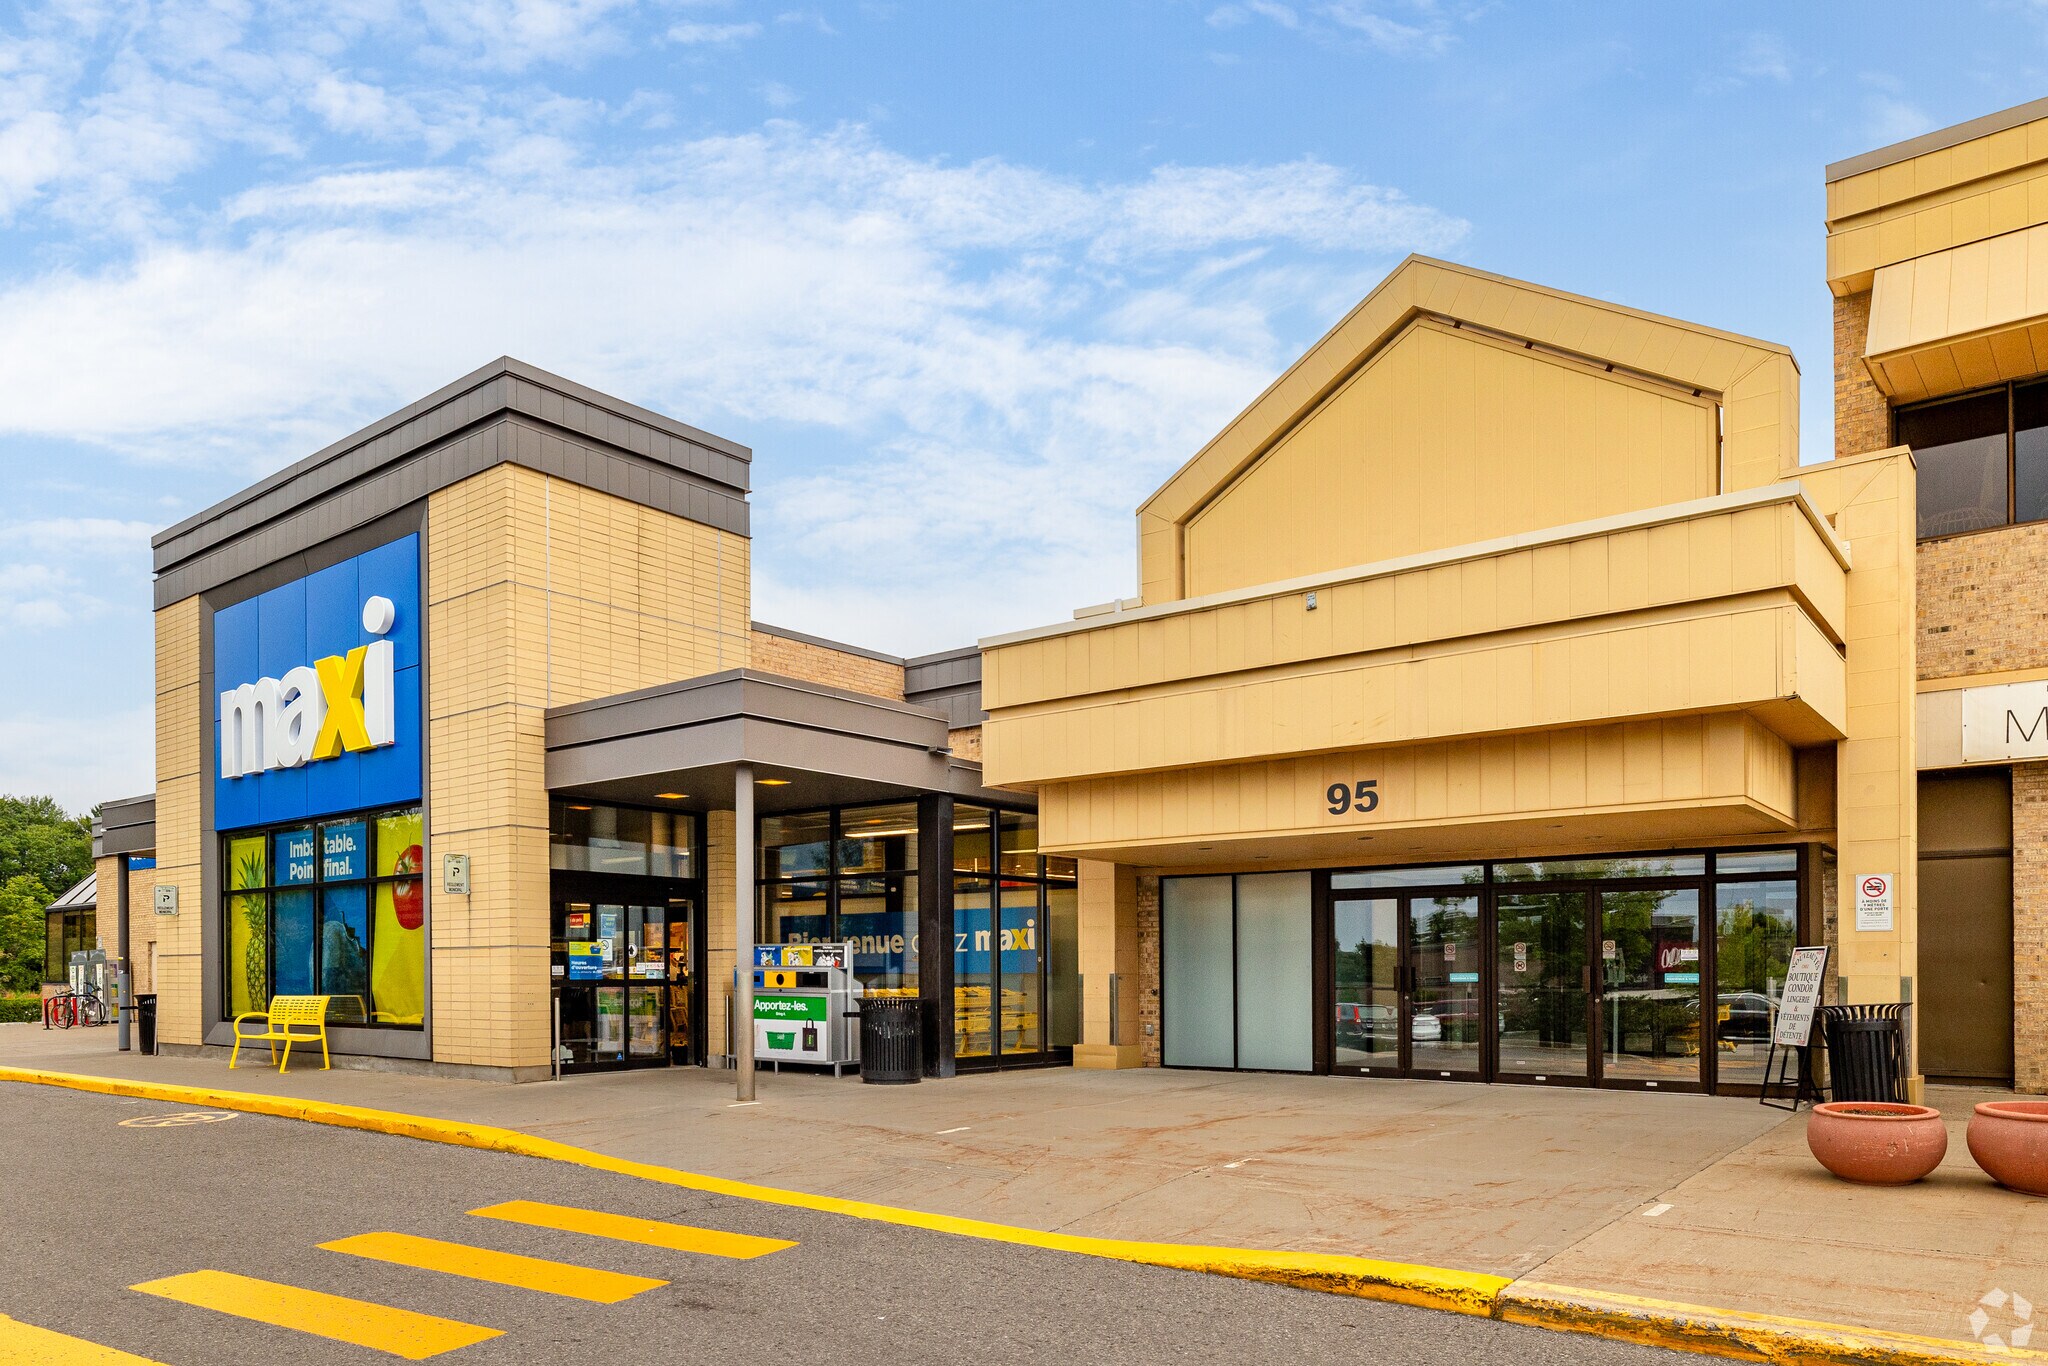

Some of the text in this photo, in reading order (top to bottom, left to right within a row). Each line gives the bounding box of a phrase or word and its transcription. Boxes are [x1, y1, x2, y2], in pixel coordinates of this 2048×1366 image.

[221, 596, 395, 779] maxi
[1326, 779, 1379, 815] 95
[289, 850, 353, 880] Poin final.
[911, 932, 969, 954] cz
[975, 919, 1036, 952] maxi
[1788, 972, 1820, 983] BOUTIQUE
[1787, 983, 1814, 993] CONDOR
[754, 999, 809, 1012] Apportez-les.
[1786, 995, 1811, 1004] LINGERIE
[1788, 1022, 1797, 1030] DE
